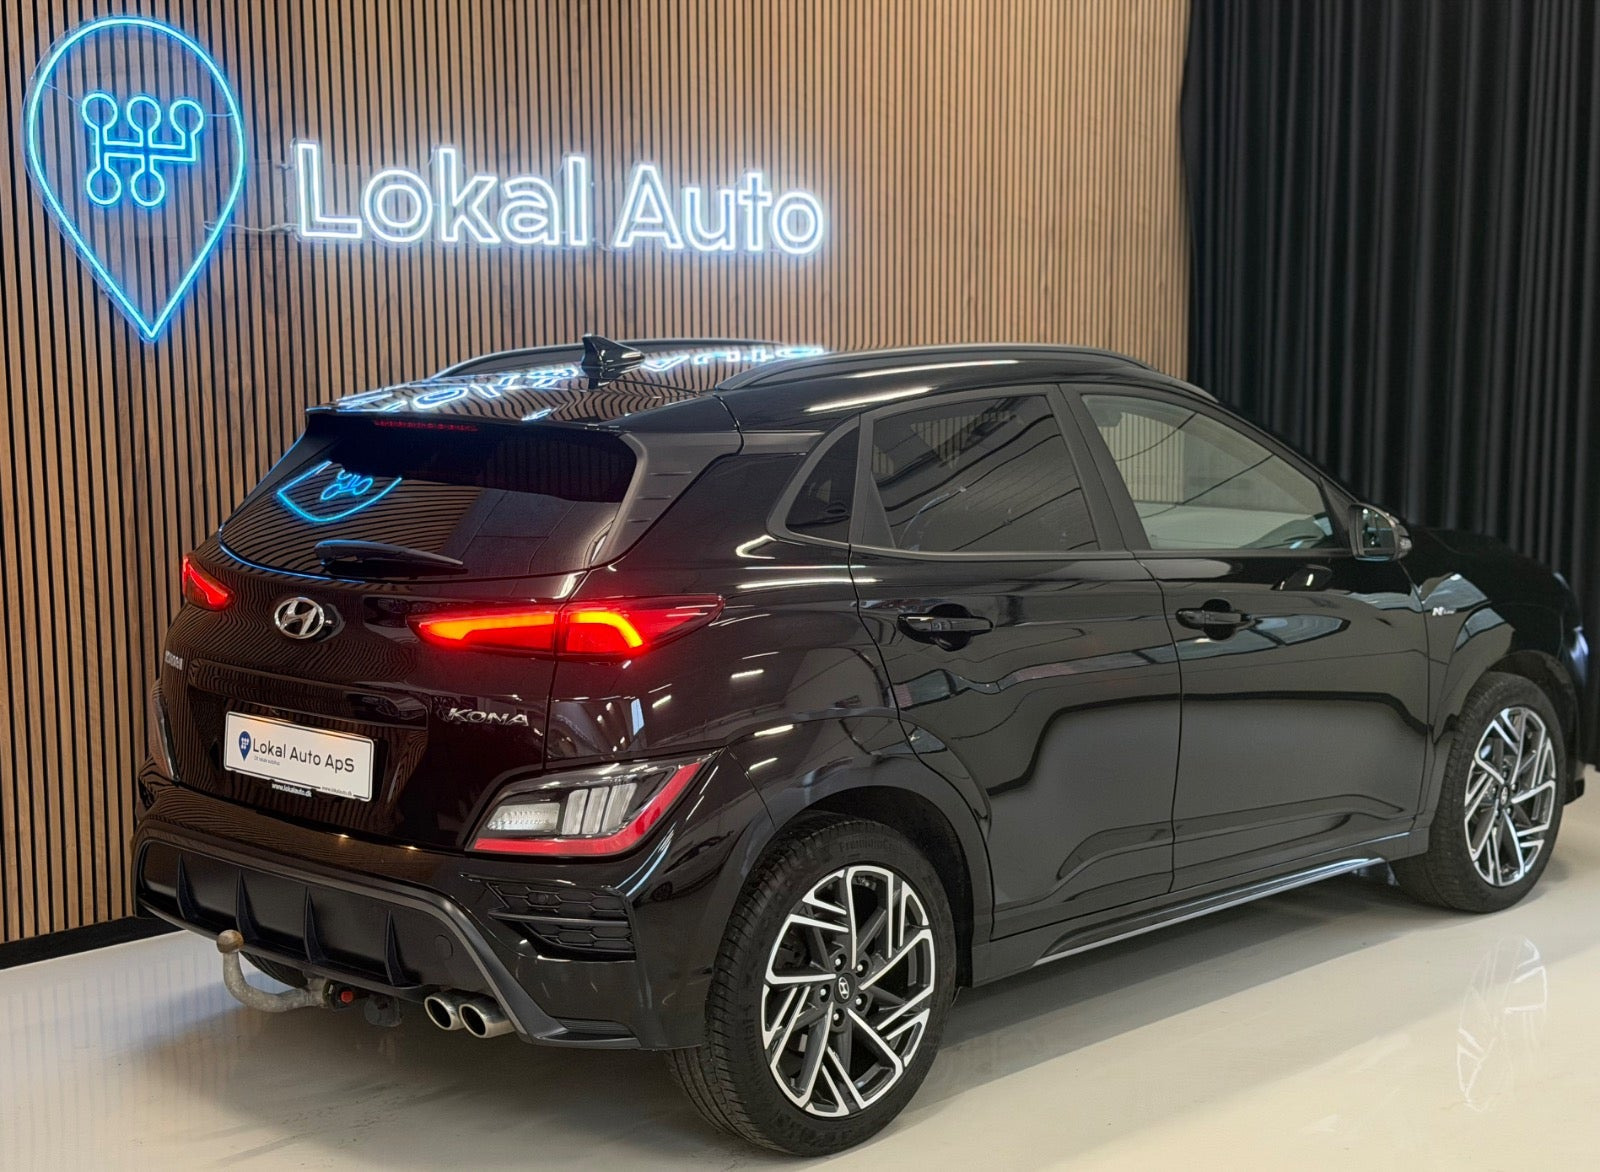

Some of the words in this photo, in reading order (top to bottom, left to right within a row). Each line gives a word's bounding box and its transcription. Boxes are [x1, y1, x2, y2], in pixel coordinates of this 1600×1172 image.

[295, 140, 588, 247] Lokal
[614, 162, 826, 256] Auto
[448, 707, 529, 726] KONA
[252, 738, 286, 758] Lokal
[289, 747, 321, 765] Auto
[325, 754, 355, 773] ApS
